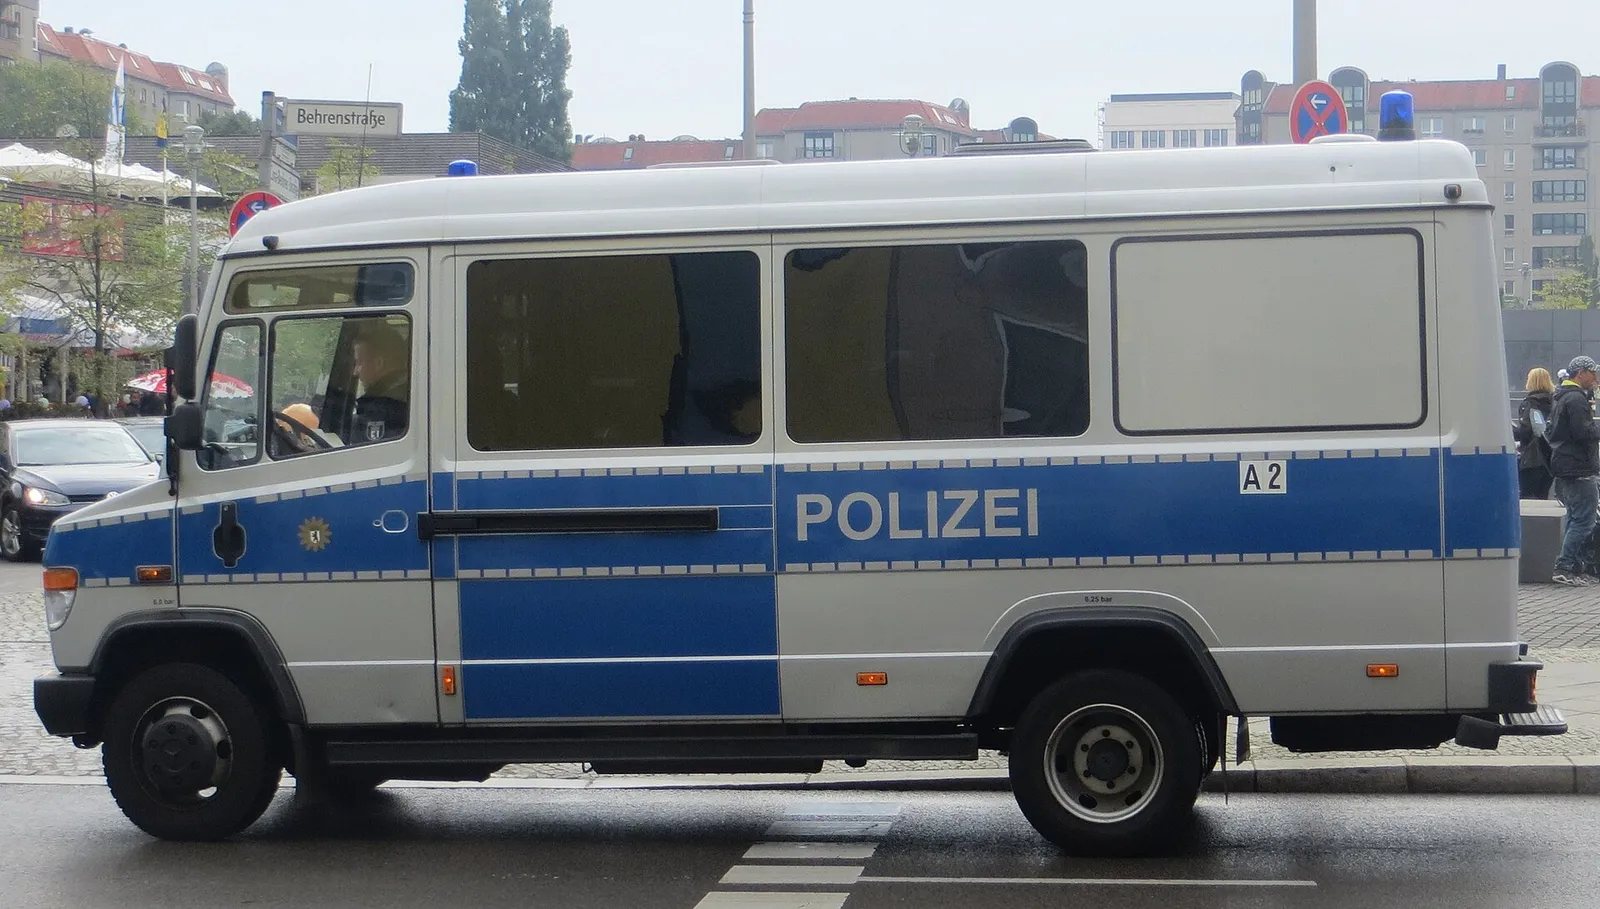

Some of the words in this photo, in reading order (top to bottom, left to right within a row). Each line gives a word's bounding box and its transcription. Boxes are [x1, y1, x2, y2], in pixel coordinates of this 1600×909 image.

[297, 108, 385, 128] Behrenstraße
[796, 488, 1039, 541] POLIZEI
[1100, 595, 1112, 603] bar
